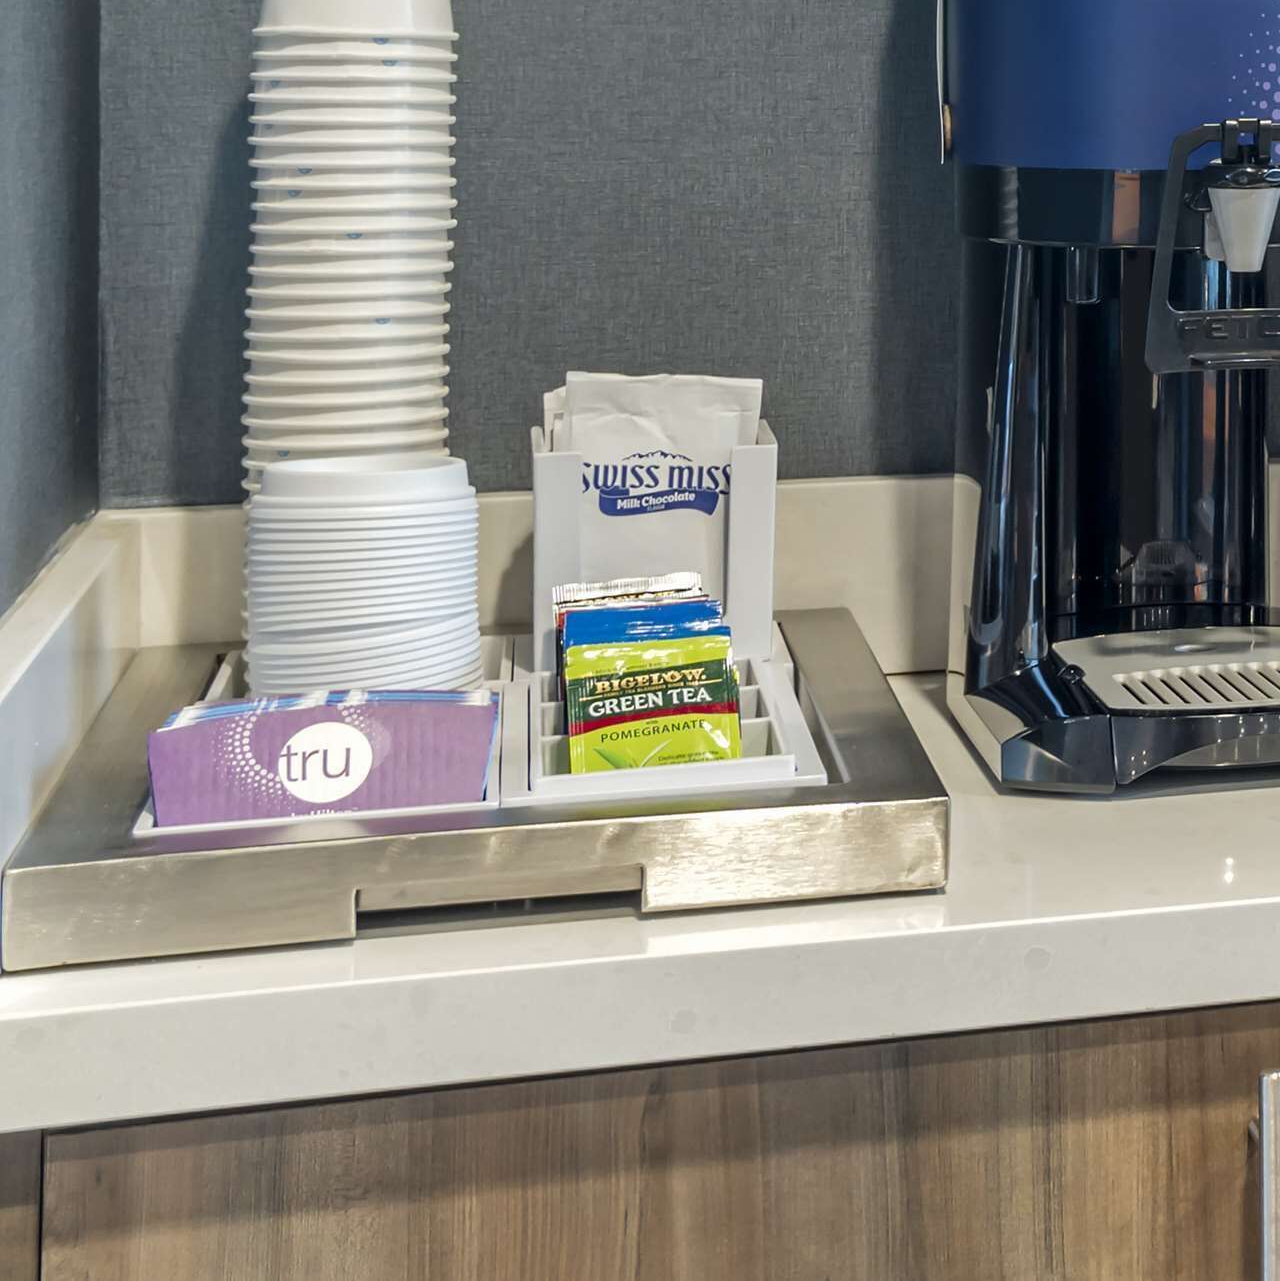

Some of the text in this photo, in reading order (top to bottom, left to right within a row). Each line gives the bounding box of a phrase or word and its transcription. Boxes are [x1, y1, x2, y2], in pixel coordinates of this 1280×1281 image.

[617, 497, 641, 510] Milk
[641, 491, 696, 507] Chocolate
[588, 691, 663, 717] GREEN
[667, 686, 713, 705] TEA
[600, 718, 706, 743] POMEGRANATE
[279, 745, 351, 783] tru
